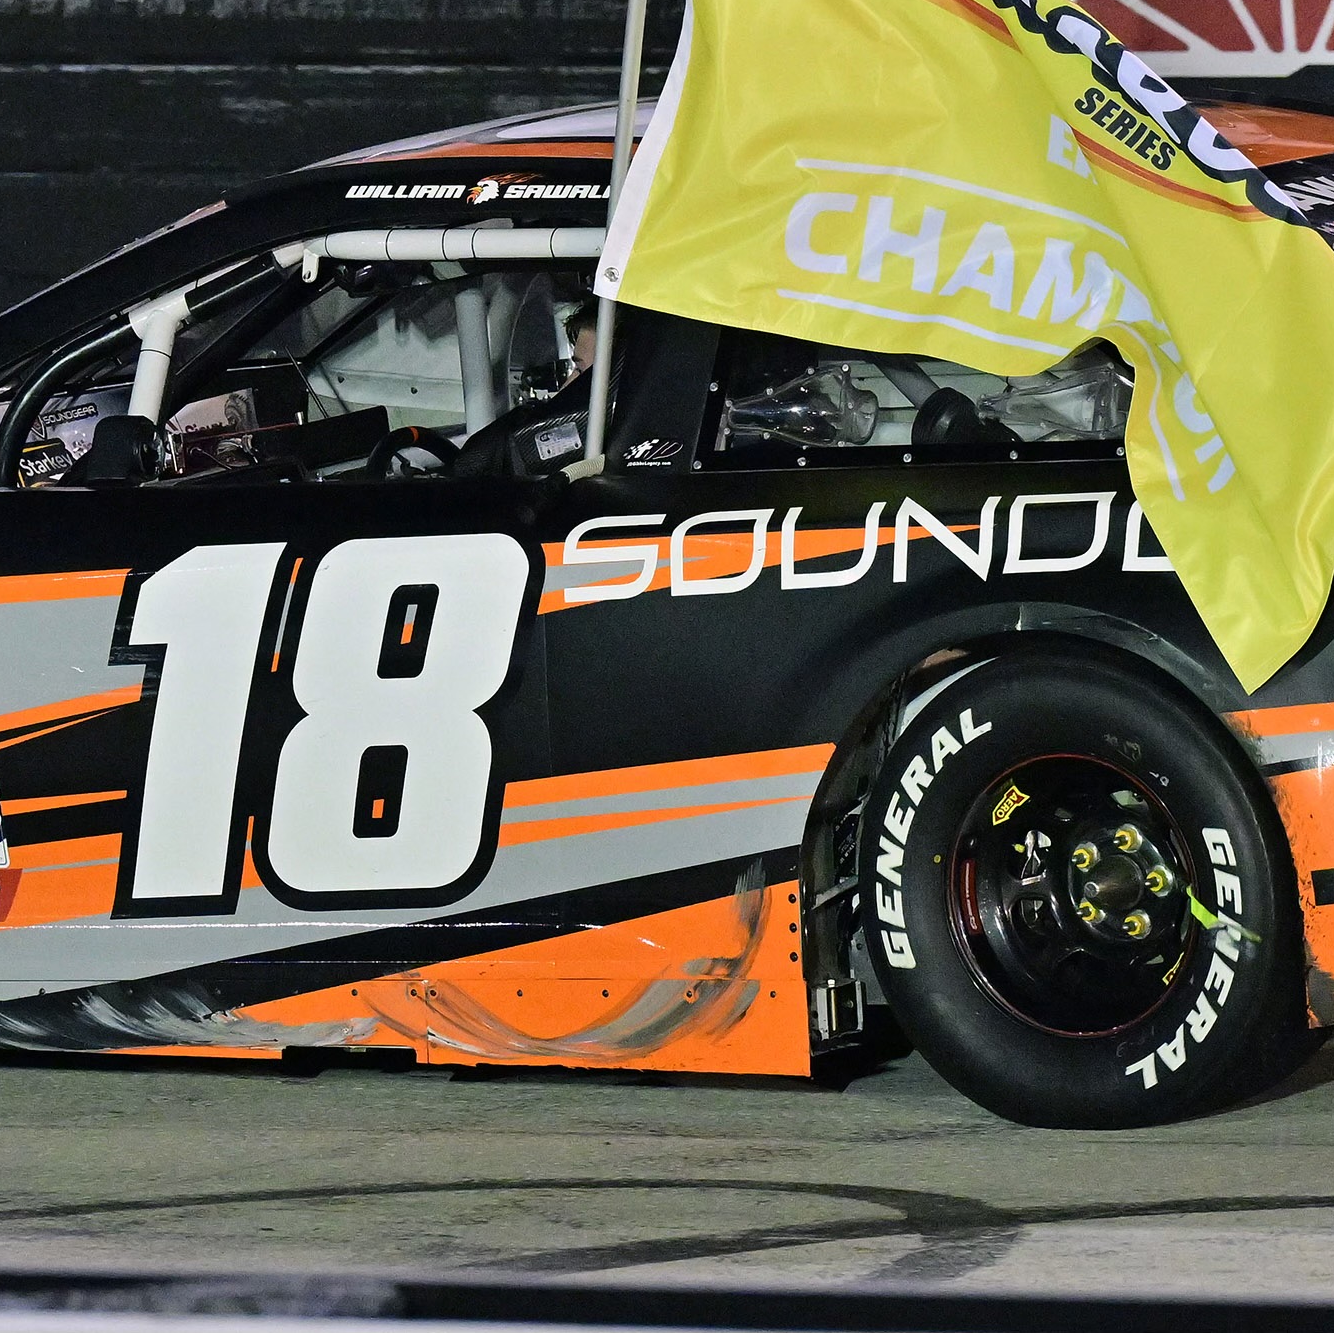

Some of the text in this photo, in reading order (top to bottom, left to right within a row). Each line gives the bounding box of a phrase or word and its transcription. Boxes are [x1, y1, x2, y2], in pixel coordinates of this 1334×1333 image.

[345, 184, 611, 199] WILLIAM SAWALI
[1074, 87, 1176, 171] SERIES
[42, 405, 97, 425] SOUNDGEAR
[125, 532, 520, 899] 18
[875, 707, 994, 970] GENERAL
[1125, 827, 1244, 1090] GENERAL
